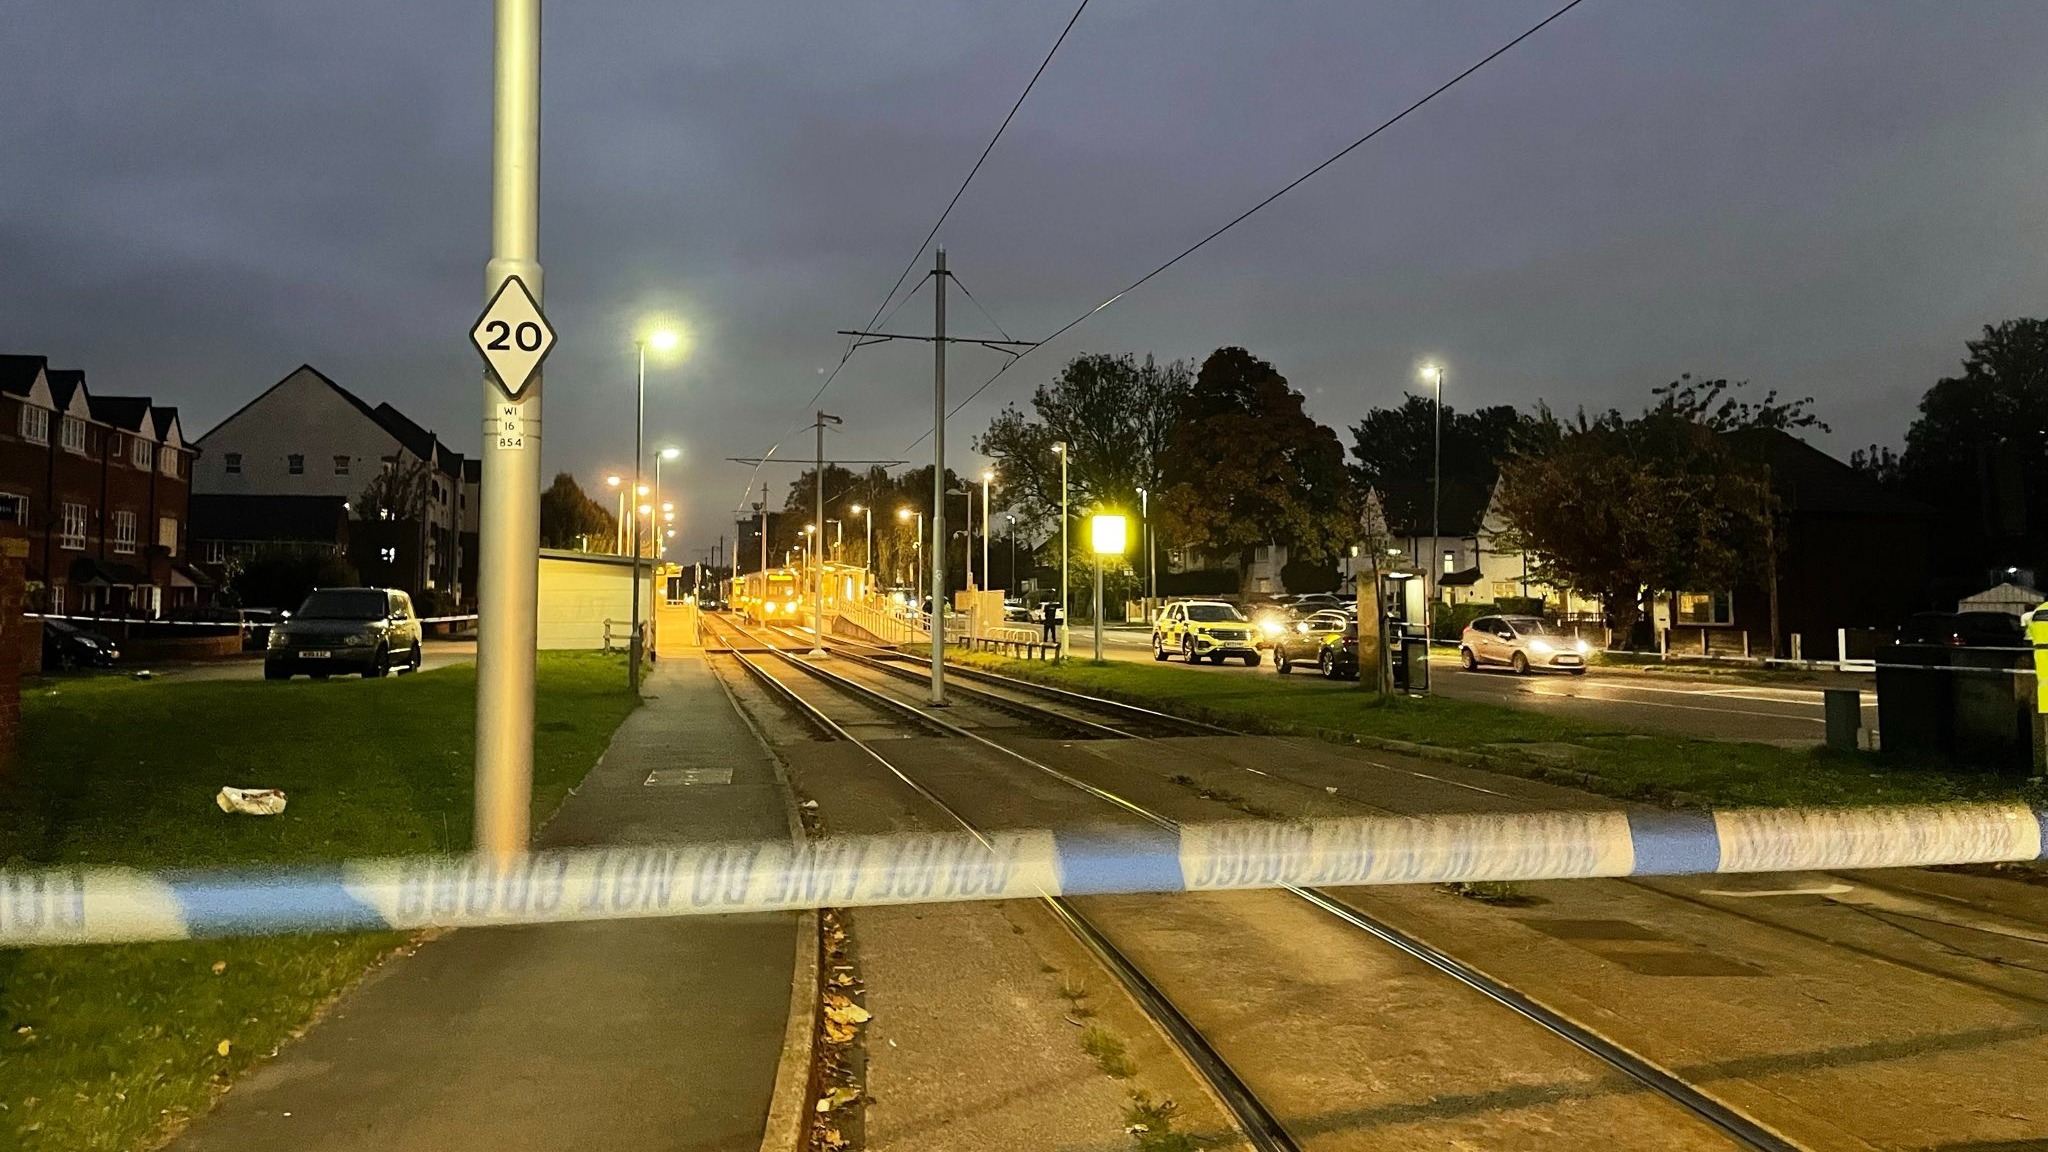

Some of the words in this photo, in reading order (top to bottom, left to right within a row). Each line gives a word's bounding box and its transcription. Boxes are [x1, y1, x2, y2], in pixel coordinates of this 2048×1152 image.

[486, 321, 542, 351] 20
[505, 422, 514, 430] 16
[500, 438, 521, 447] 854
